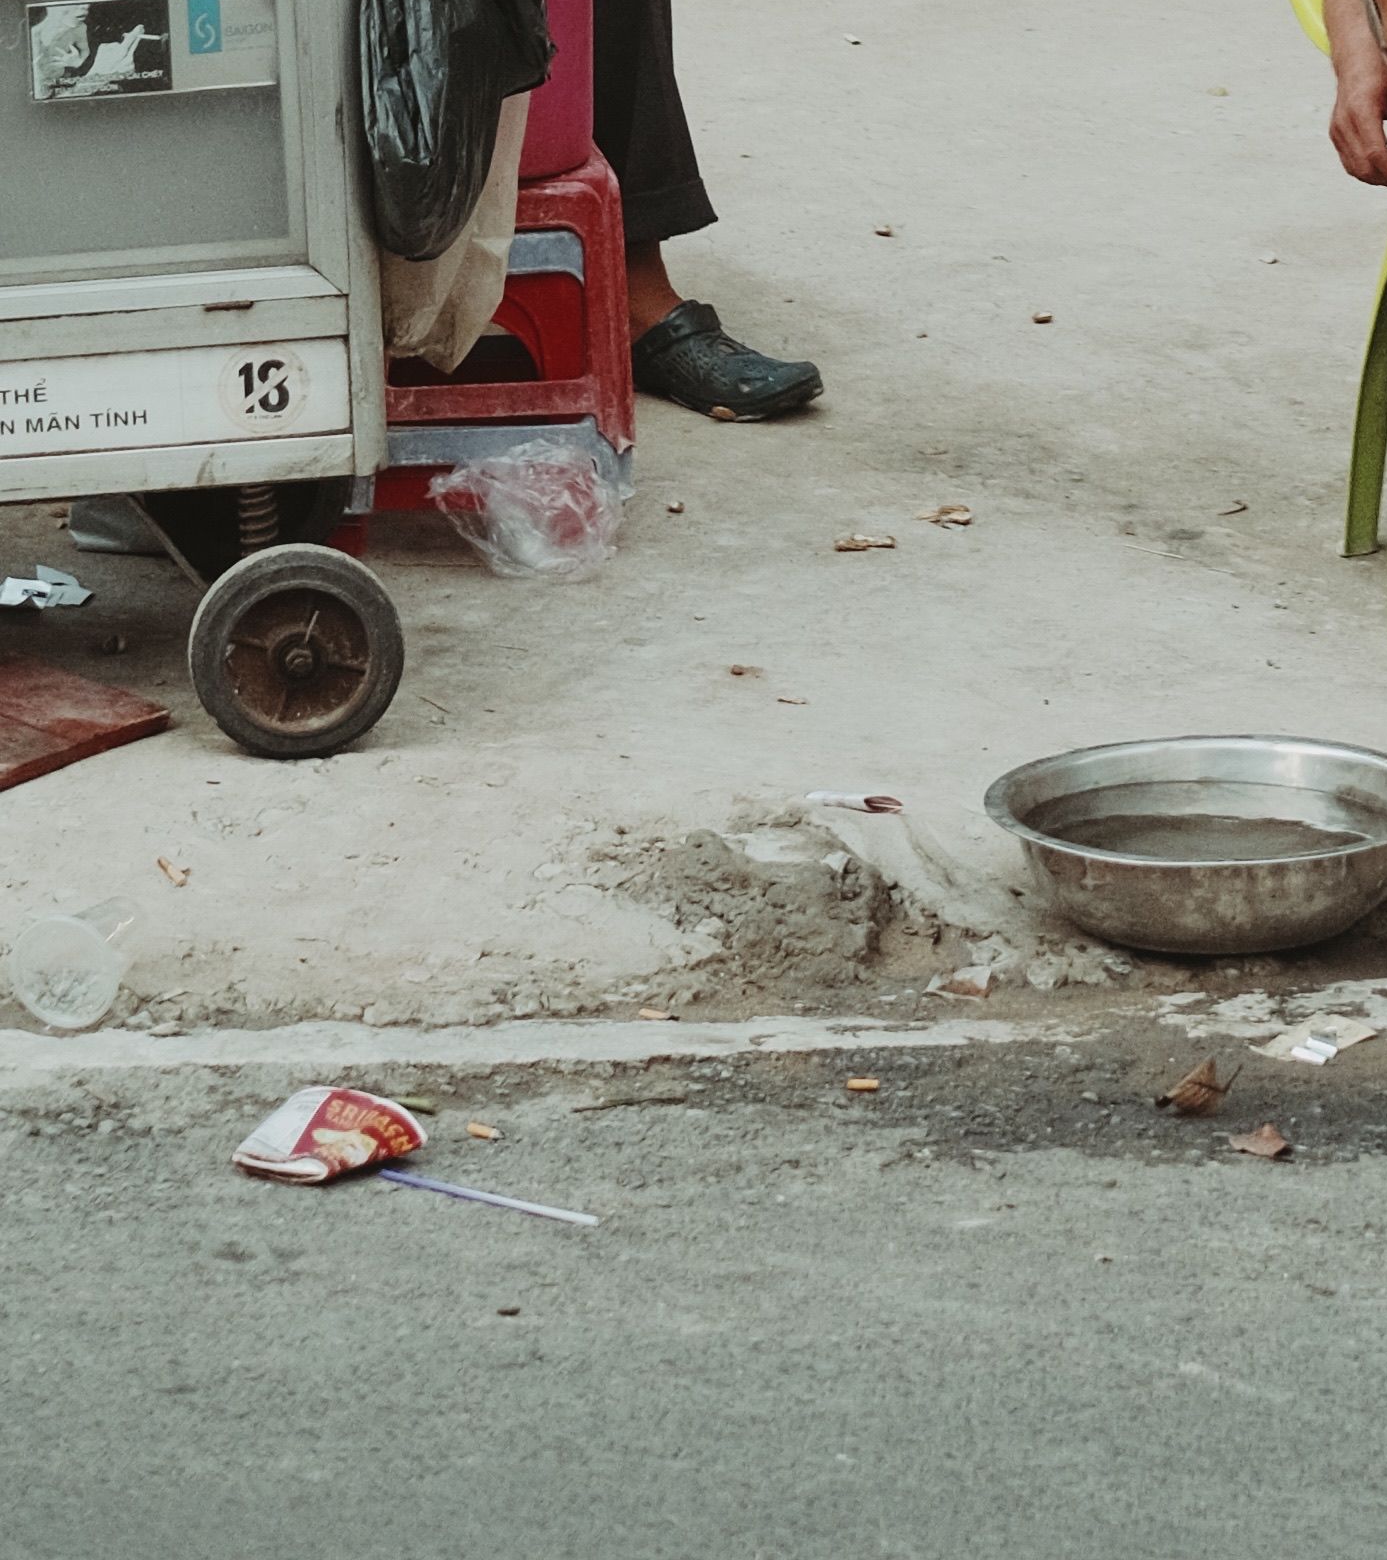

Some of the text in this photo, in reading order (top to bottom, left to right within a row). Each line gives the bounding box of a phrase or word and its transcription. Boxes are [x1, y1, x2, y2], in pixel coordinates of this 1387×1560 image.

[238, 359, 291, 414] 18
[25, 412, 80, 433] MÃN
[90, 408, 148, 429] TÍNH
